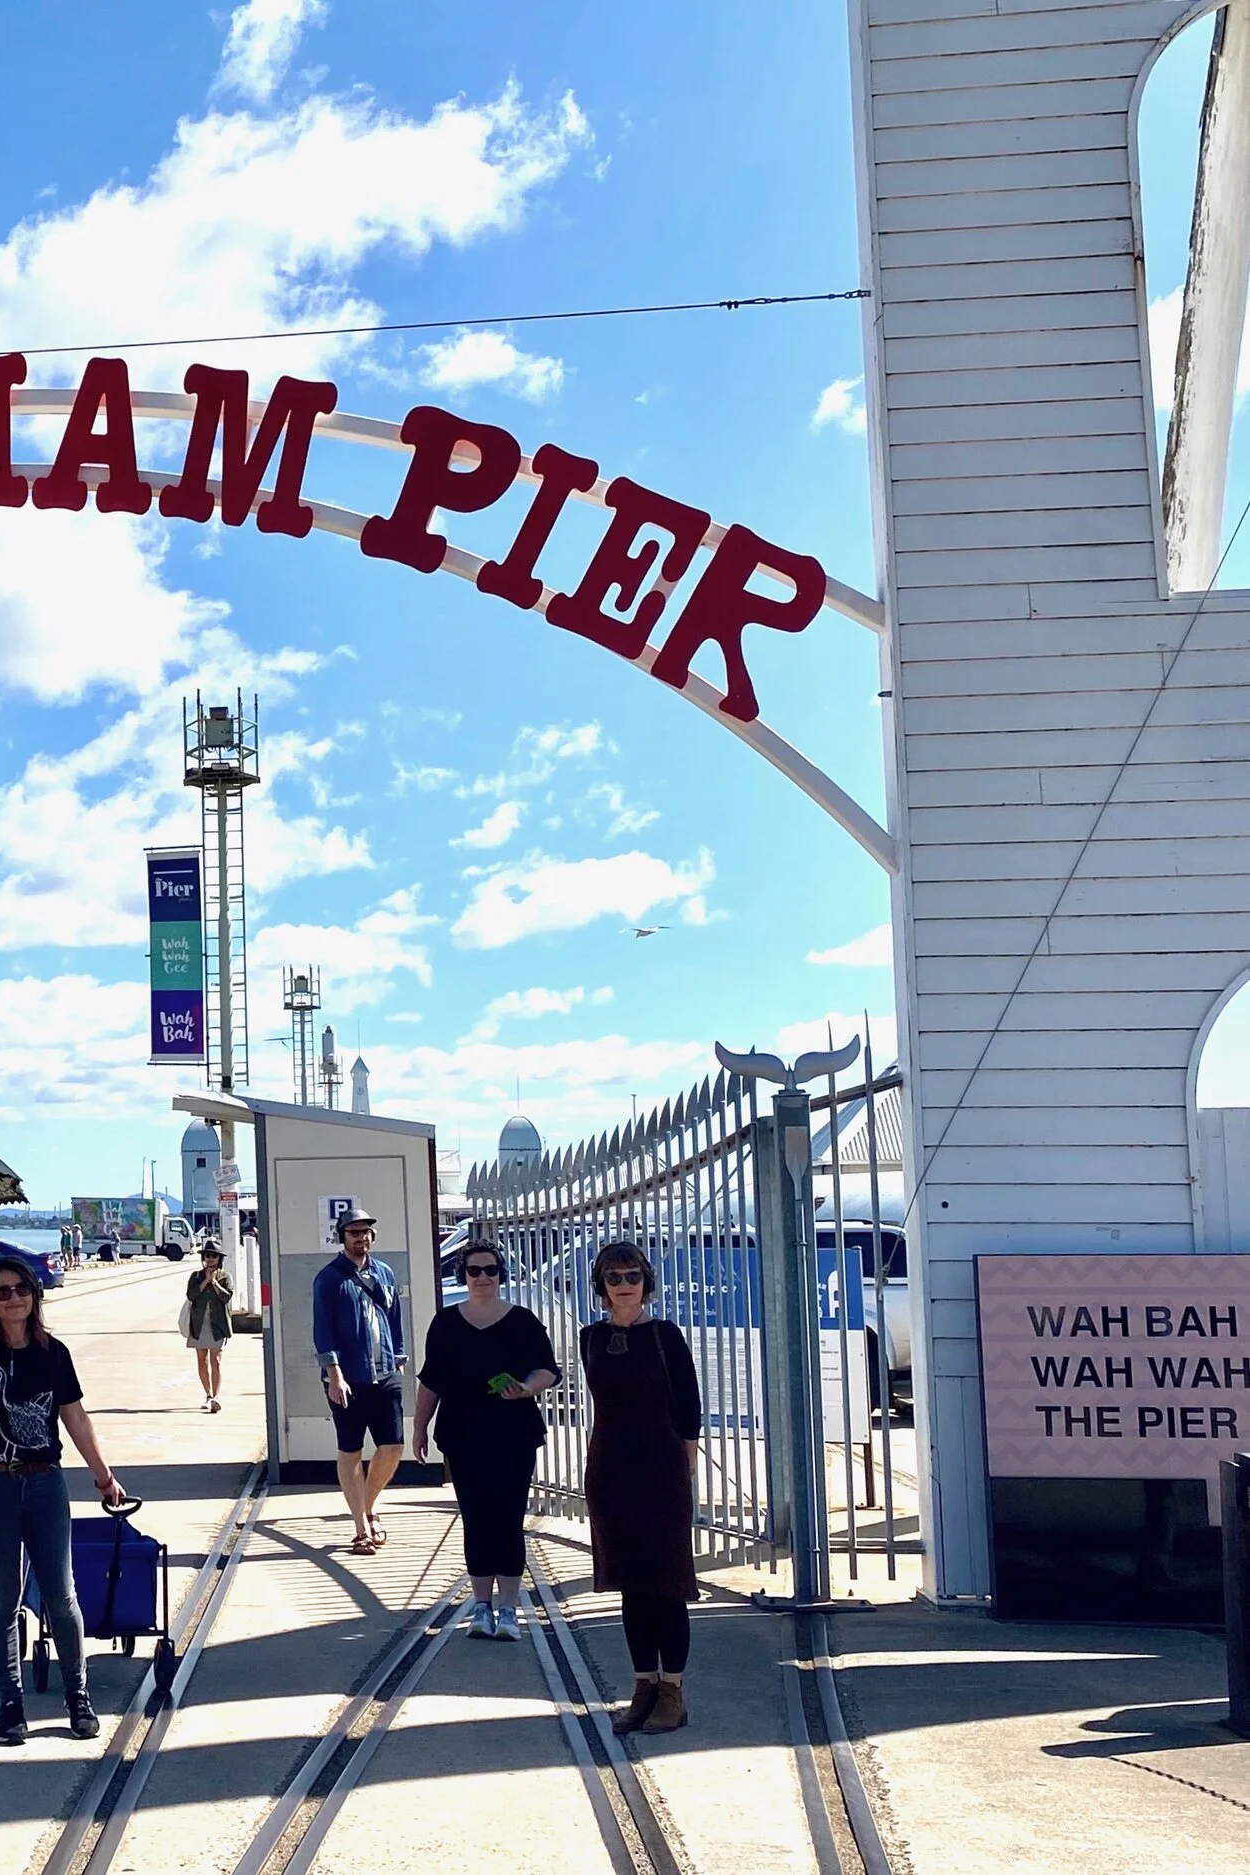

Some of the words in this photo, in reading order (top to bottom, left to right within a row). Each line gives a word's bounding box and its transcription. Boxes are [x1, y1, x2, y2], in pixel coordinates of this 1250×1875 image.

[360, 406, 826, 722] PIER
[154, 880, 194, 897] Pier
[161, 936, 190, 950] Wah
[161, 950, 190, 962] Wah
[159, 1010, 196, 1028] Wah
[163, 1025, 195, 1043] Bah
[334, 1201, 349, 1219] P
[1027, 1305, 1130, 1337] WAH
[1145, 1305, 1239, 1337] BAH
[1030, 1356, 1133, 1388] WAH
[1147, 1356, 1250, 1389] WAH
[1035, 1405, 1122, 1437] THE
[1138, 1406, 1240, 1438] PIER
